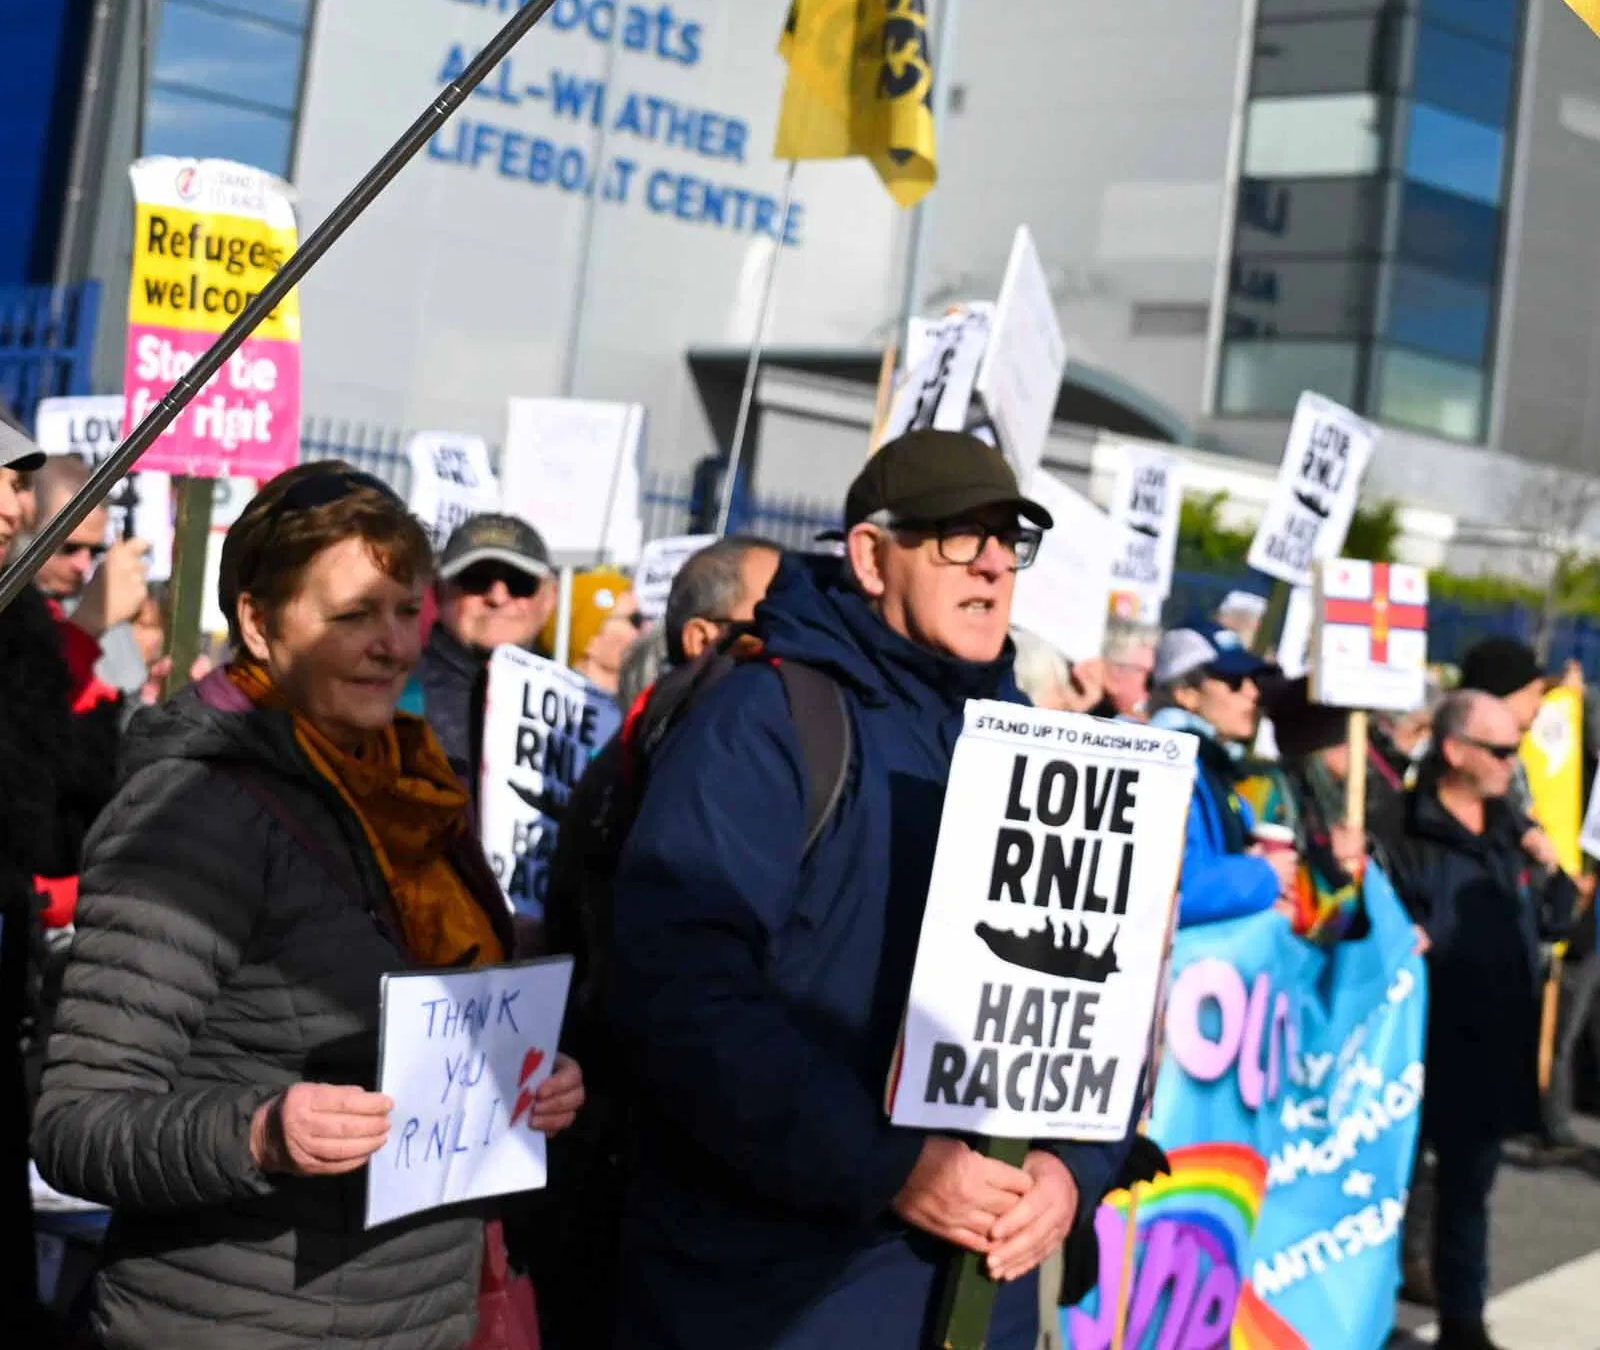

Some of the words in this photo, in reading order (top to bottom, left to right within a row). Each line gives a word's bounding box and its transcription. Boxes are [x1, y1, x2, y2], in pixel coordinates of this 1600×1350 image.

[646, 169, 803, 245] CENTRE
[144, 274, 278, 321] welco
[68, 417, 122, 443] LOV
[522, 679, 598, 747] LOVE
[975, 716, 1029, 736] STAND
[1032, 724, 1052, 739] UP
[1057, 728, 1078, 744] TO
[515, 725, 585, 790] RNL
[1005, 754, 1140, 834] LOVE
[988, 827, 1134, 916] RNLI
[421, 989, 521, 1039] THANK
[973, 982, 1100, 1050] HATE
[924, 1042, 1120, 1115] RACISM
